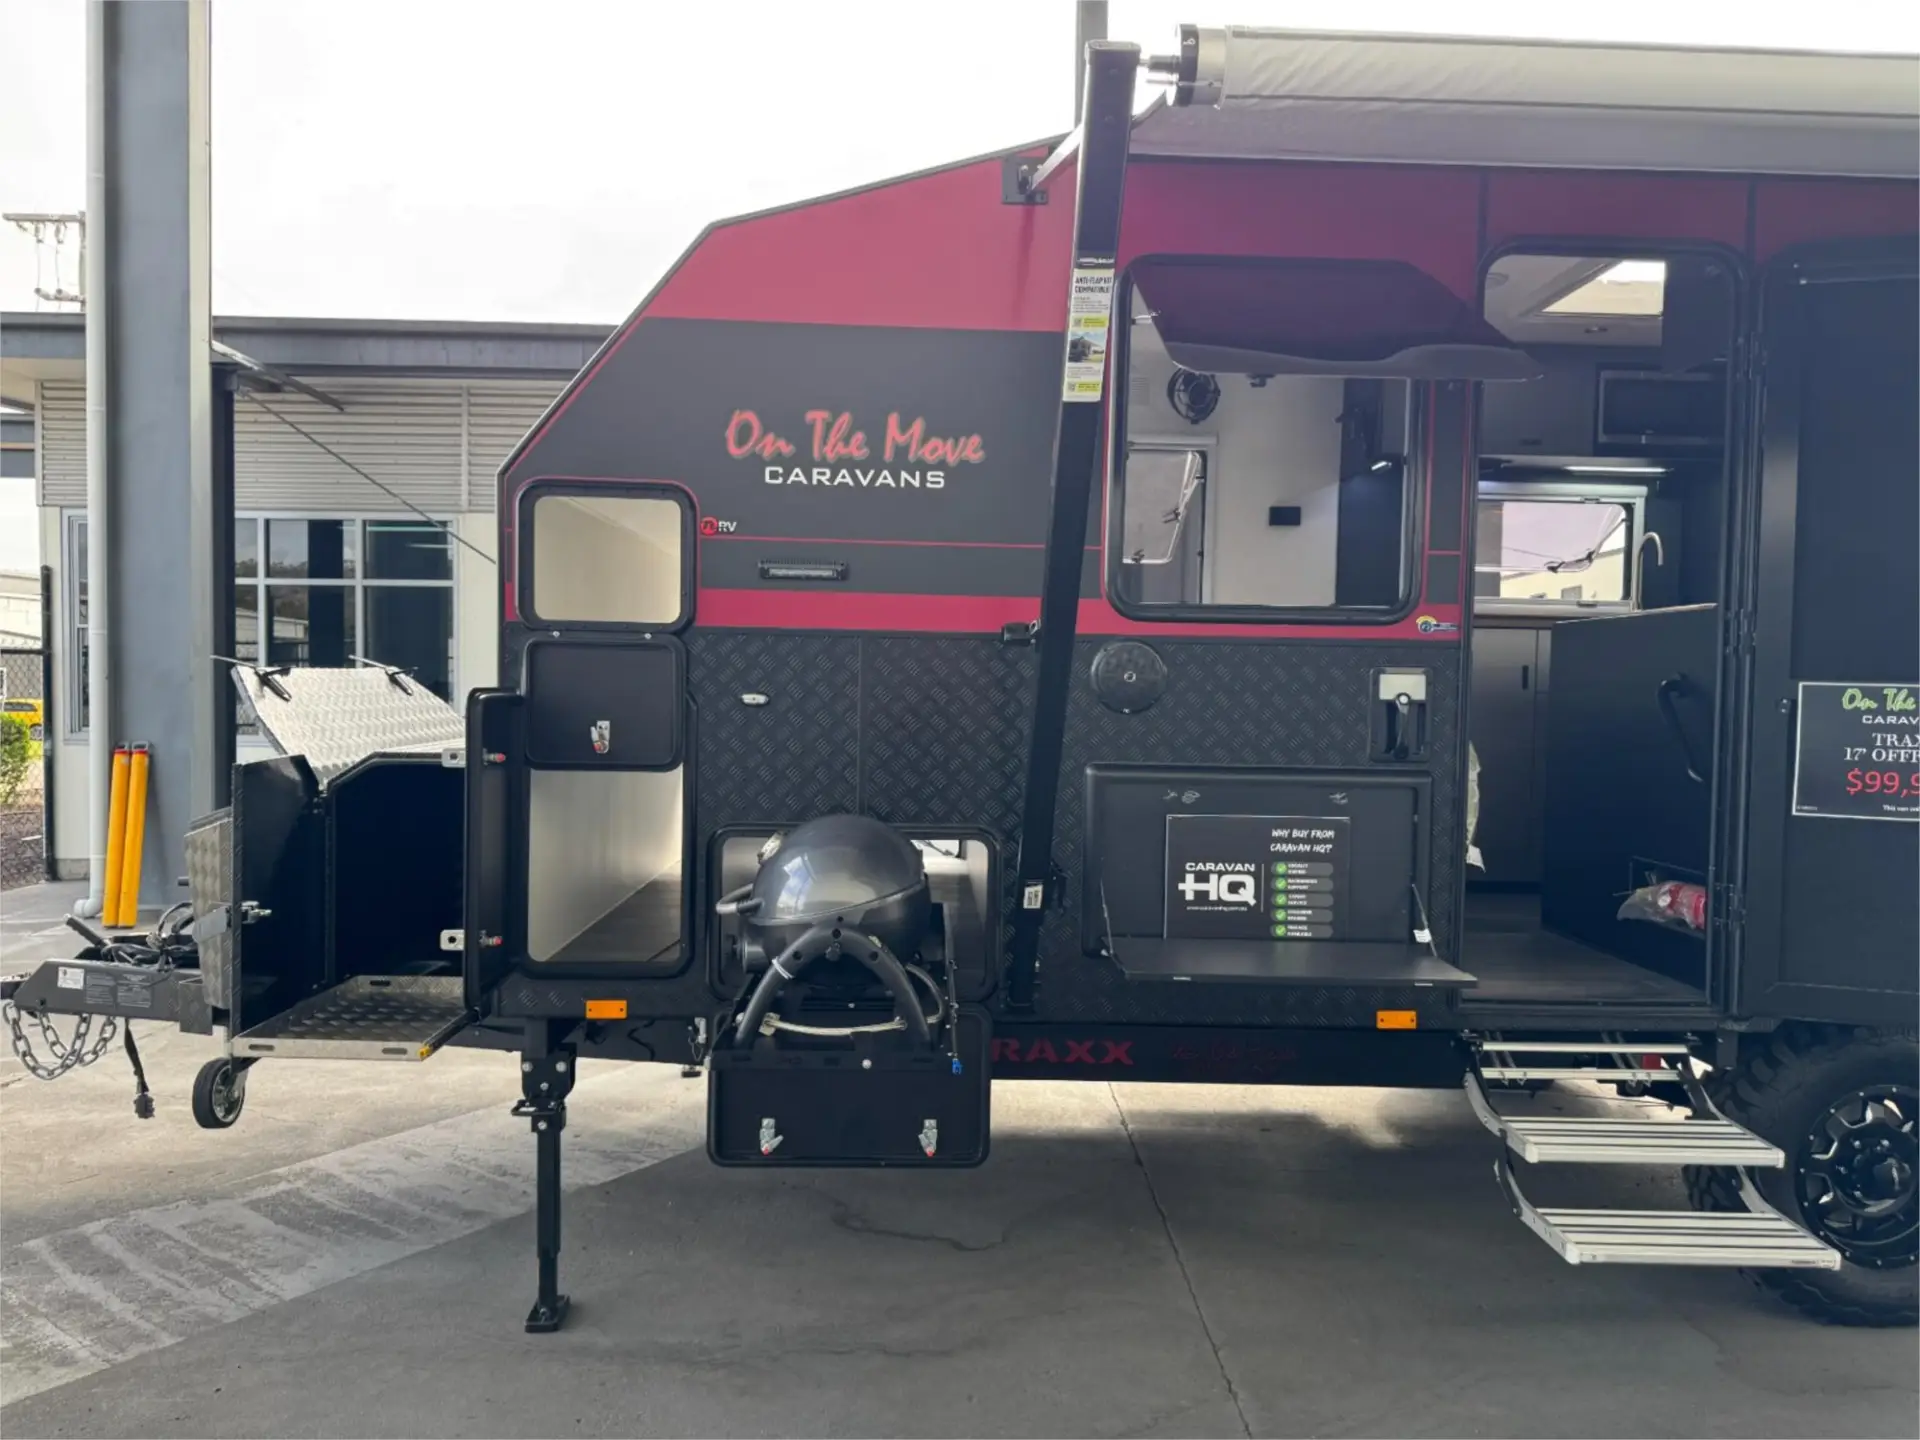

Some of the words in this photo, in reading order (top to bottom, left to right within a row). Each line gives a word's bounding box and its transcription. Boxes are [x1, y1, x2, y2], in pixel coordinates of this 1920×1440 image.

[725, 410, 796, 460] On
[805, 410, 870, 463] The
[884, 412, 985, 466] Move
[764, 466, 945, 489] CARAVANS
[1842, 688, 1878, 711] On
[1883, 688, 1916, 712] The
[1862, 715, 1919, 725] CARAV
[1271, 828, 1290, 838] WHY
[1292, 829, 1309, 839] BUY
[1311, 829, 1335, 839] FROM
[1270, 842, 1311, 853] CARAVAN
[1185, 862, 1255, 872] CARAVAN
[1178, 873, 1257, 907] HQ
